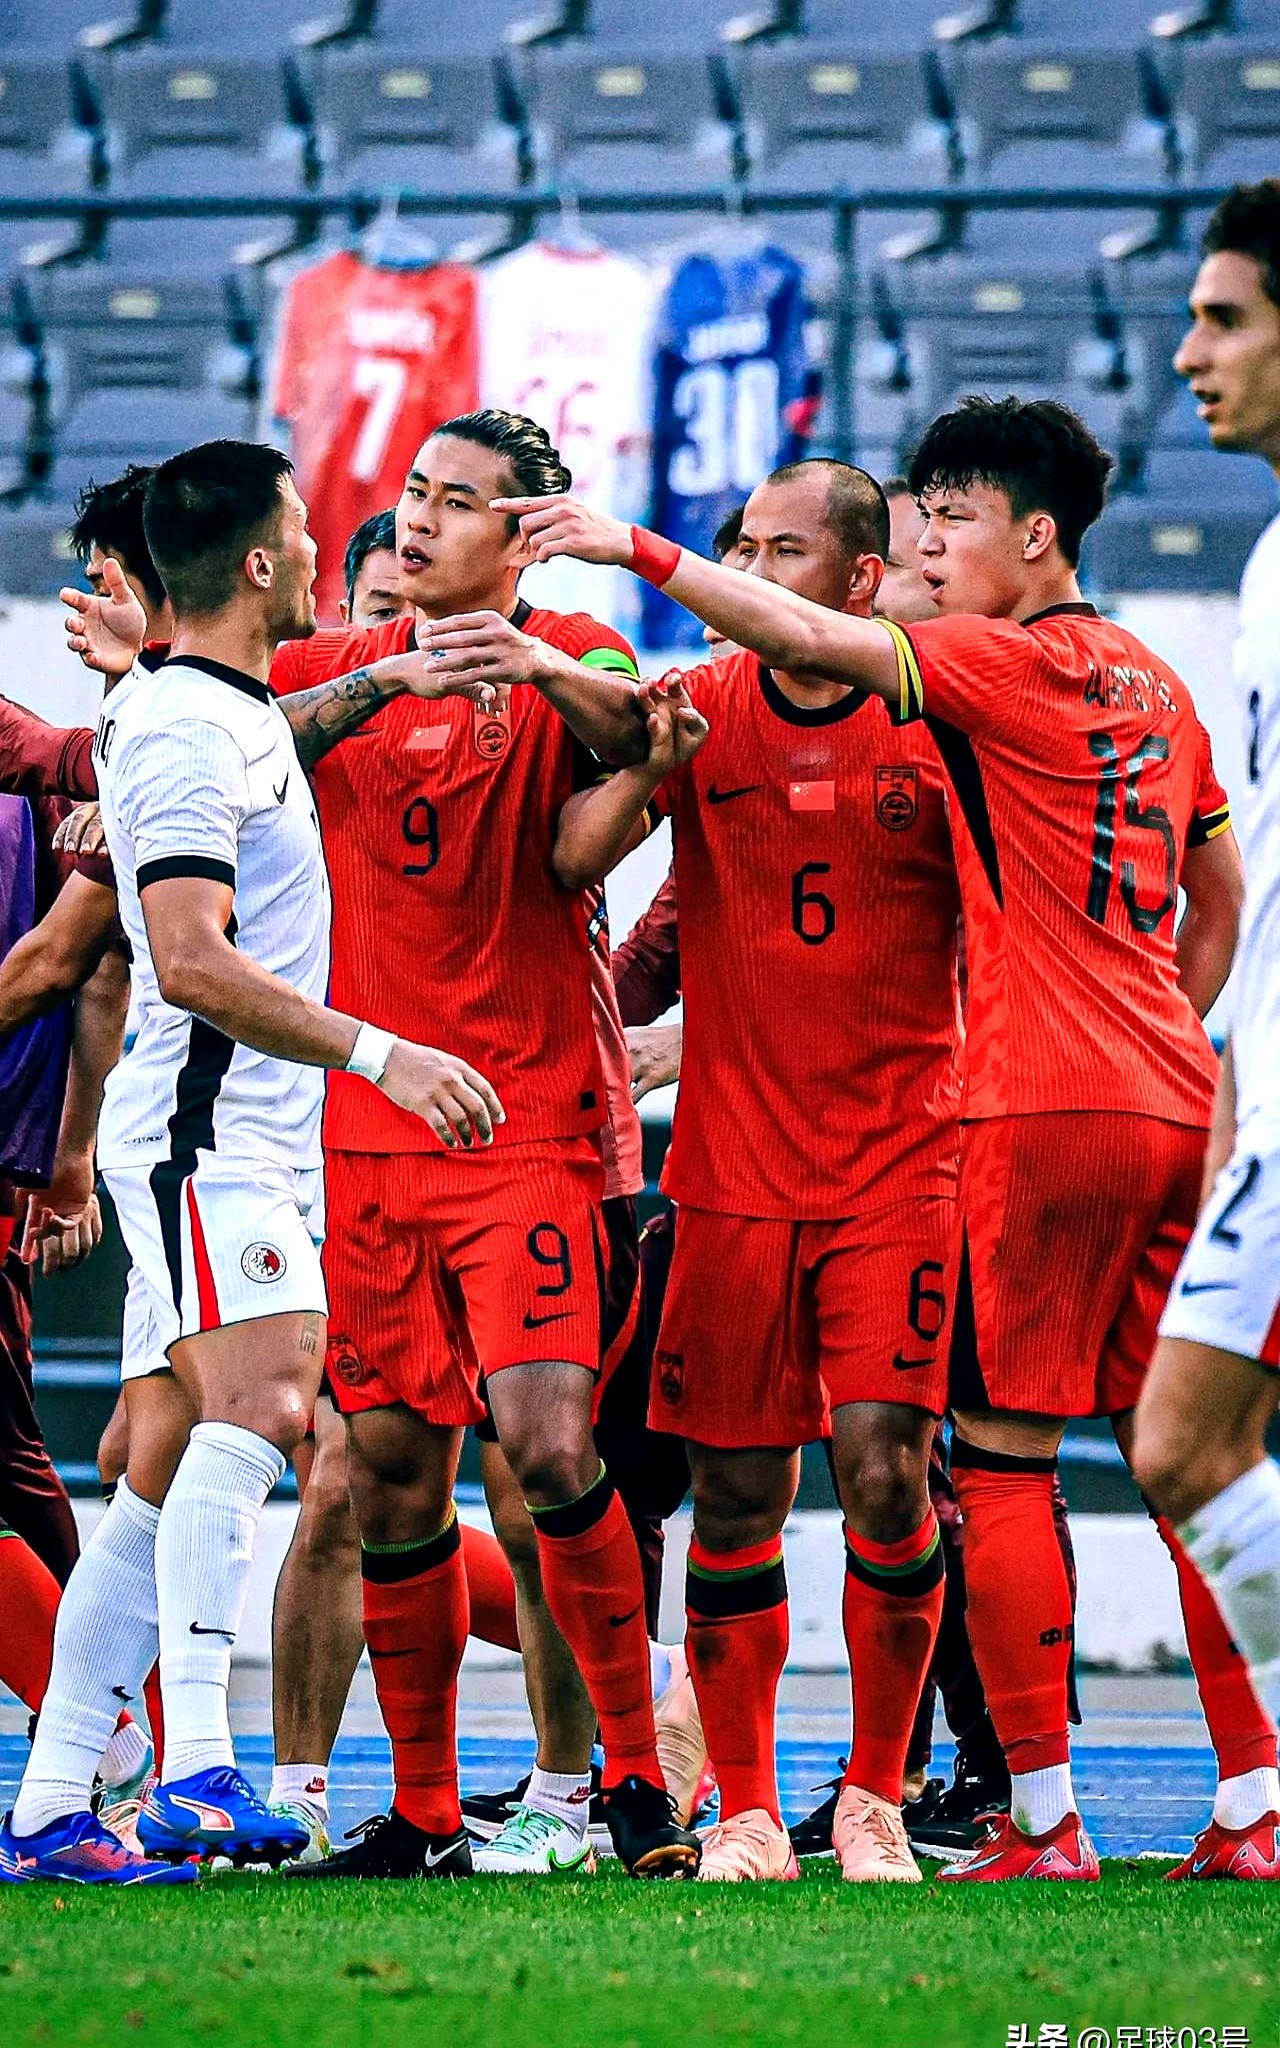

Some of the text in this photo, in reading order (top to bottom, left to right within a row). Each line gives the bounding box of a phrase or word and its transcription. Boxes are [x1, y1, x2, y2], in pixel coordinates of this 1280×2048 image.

[353, 359, 407, 483] 7
[667, 362, 780, 496] 30
[402, 797, 441, 876] 9
[1088, 732, 1177, 933] 15
[792, 862, 836, 946] 6
[1211, 1155, 1260, 1248] 2
[528, 1221, 572, 1296] 9
[908, 1261, 946, 1342] 6
